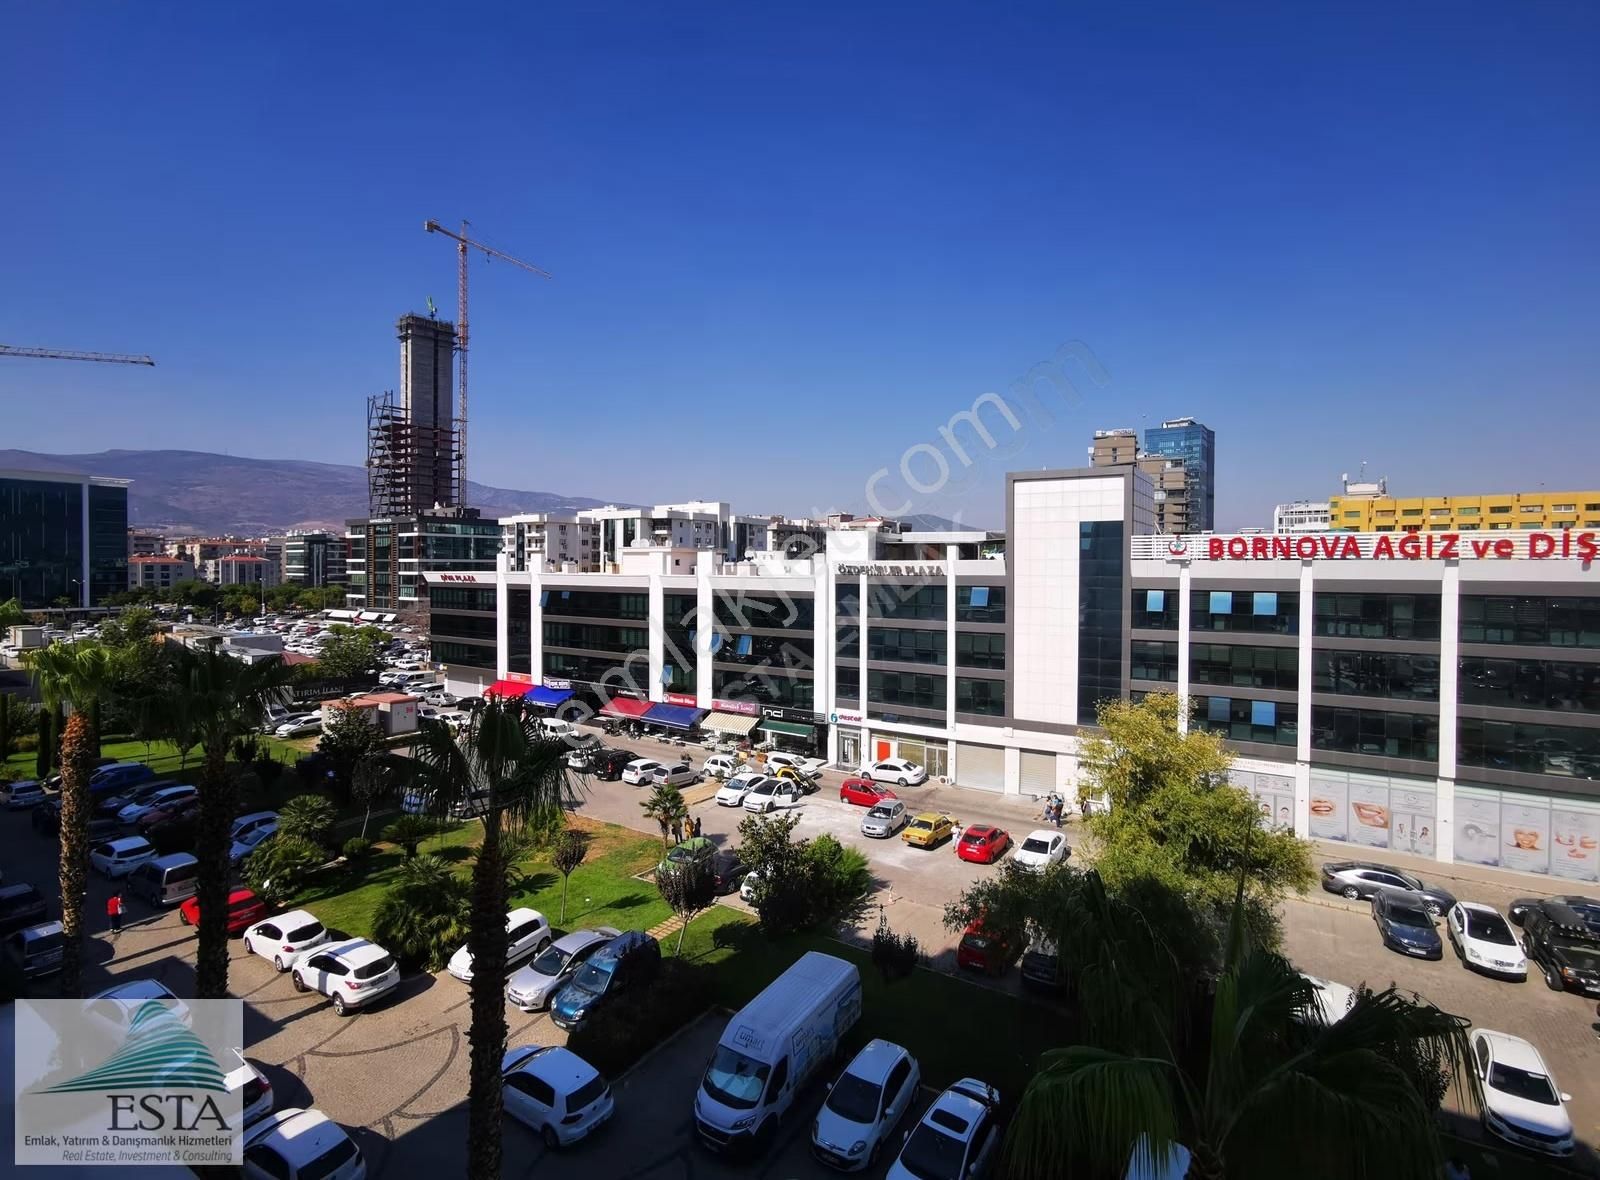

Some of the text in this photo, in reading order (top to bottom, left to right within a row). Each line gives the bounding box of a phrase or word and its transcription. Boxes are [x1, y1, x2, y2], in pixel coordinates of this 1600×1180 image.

[1208, 526, 1598, 565] BORNOVA AĞIZ ve DİŞ
[905, 565, 945, 576] PLAZA
[455, 574, 477, 583] PLAZA
